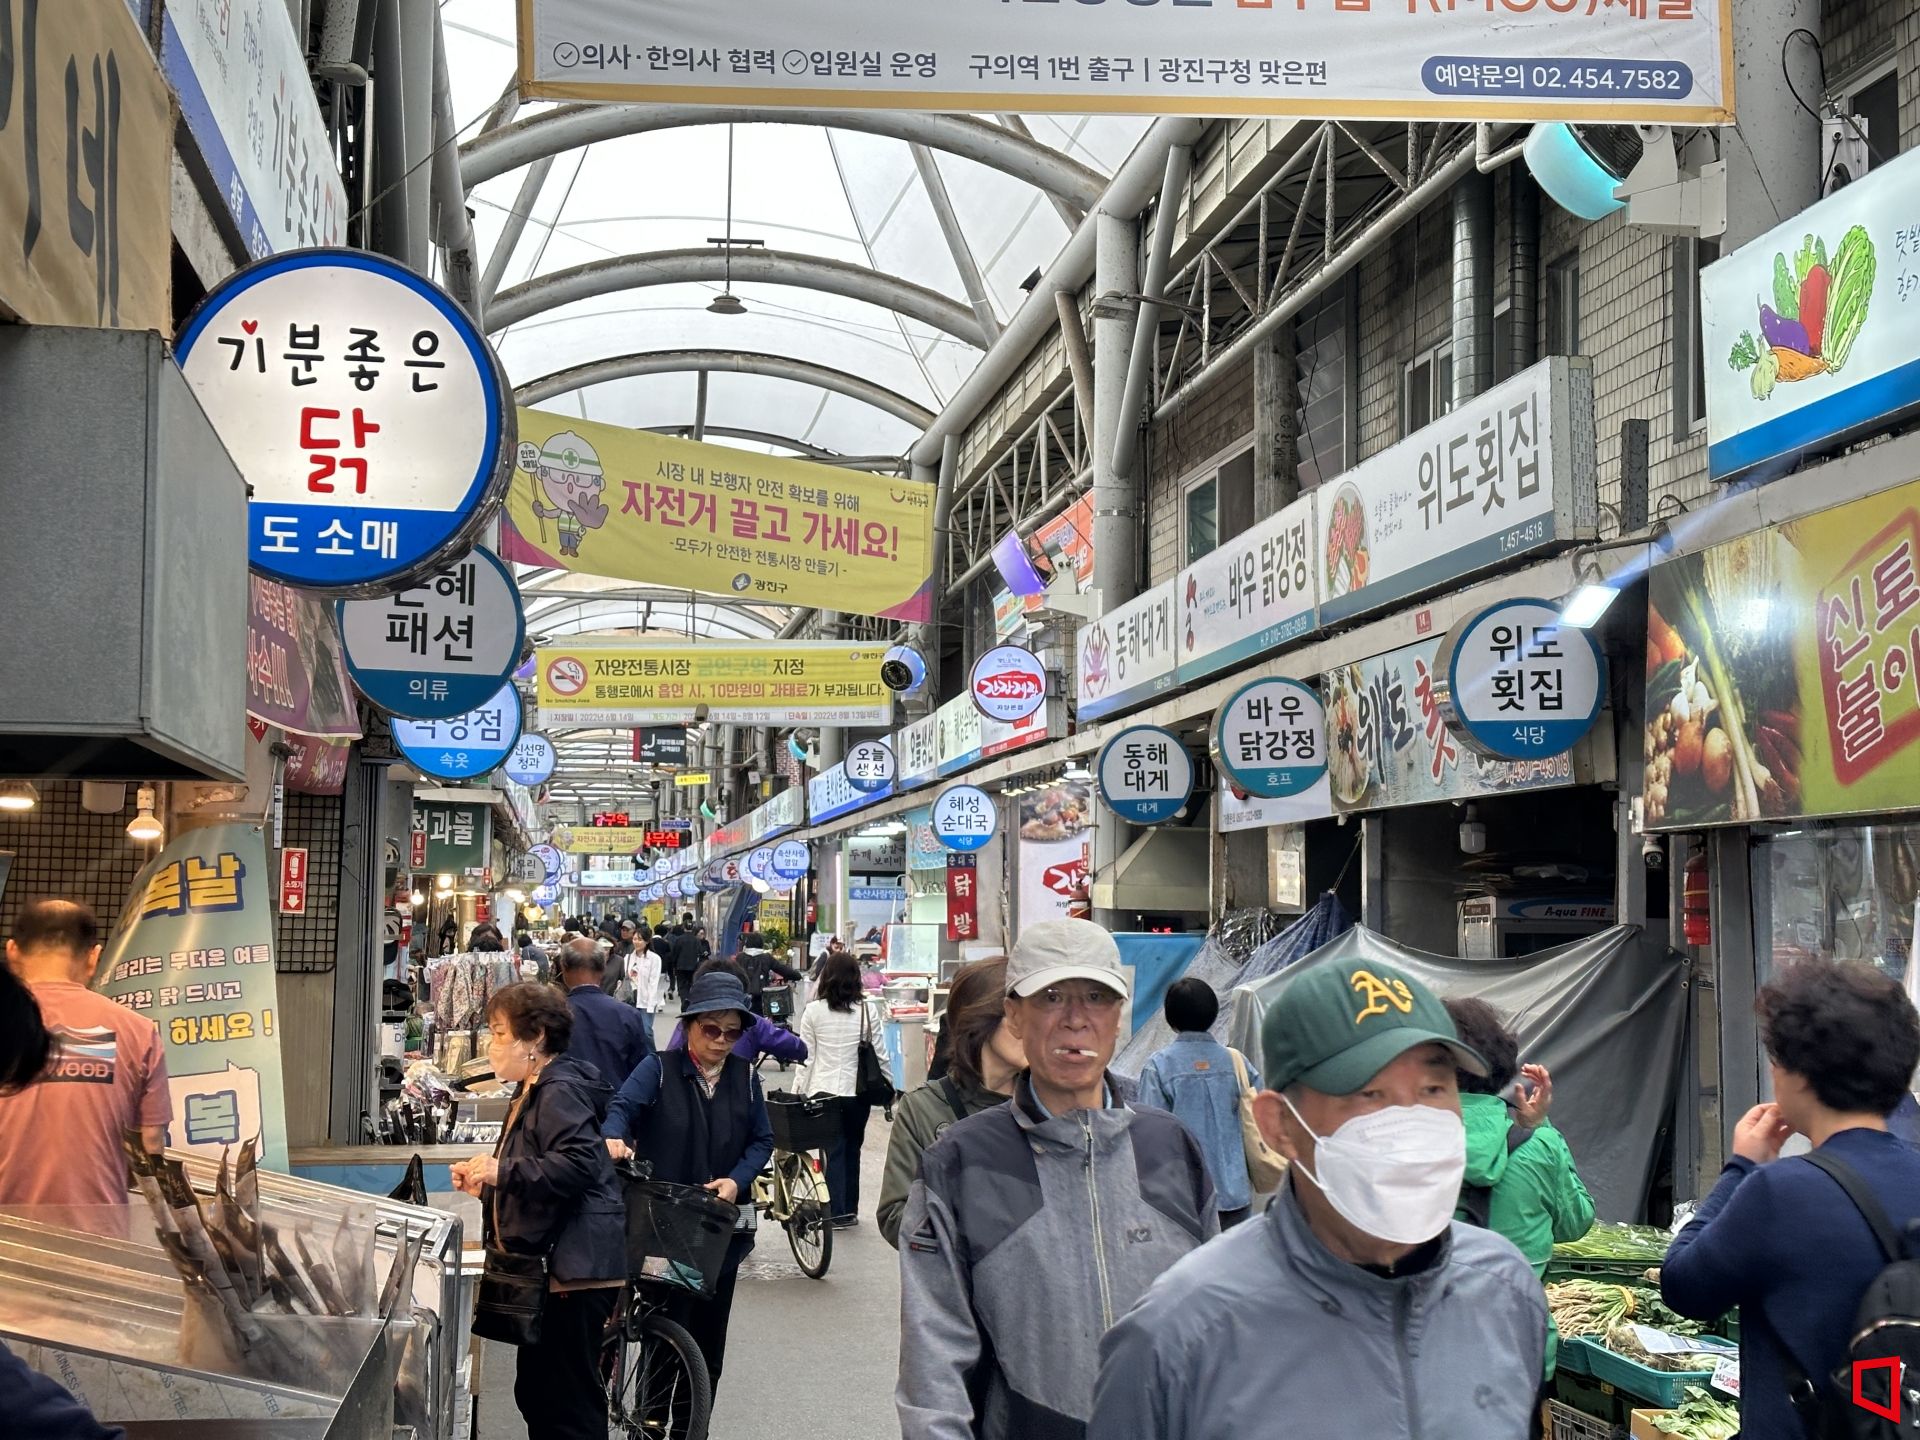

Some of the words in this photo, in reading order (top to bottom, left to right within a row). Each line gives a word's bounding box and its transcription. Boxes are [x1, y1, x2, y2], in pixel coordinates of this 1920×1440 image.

[582, 44, 721, 72] 의사·한의사
[728, 47, 776, 75] 협력
[809, 49, 882, 77] 입원실
[889, 51, 938, 78] 운영
[968, 53, 1040, 81] 구의역
[1047, 54, 1081, 82] 1번
[1088, 55, 1135, 84] 출구
[1158, 56, 1251, 85] 광진구청
[1258, 59, 1328, 87] 맞은편
[1434, 63, 1526, 90] 예약문의
[1531, 68, 1682, 91] 02.454.7582
[218, 322, 446, 392] 기분좋은
[300, 407, 380, 494] 닭
[521, 450, 536, 459] 안전
[1417, 391, 1541, 531] 위도횟집
[656, 460, 686, 482] 시장
[690, 467, 704, 486] 내
[710, 471, 752, 493] 보행자
[756, 477, 784, 499] 안전
[788, 484, 830, 508] 확보를
[833, 490, 860, 513] 위해
[620, 479, 717, 533] 자전거
[730, 497, 791, 544] 끌고
[802, 507, 899, 562] 가세요!
[1499, 520, 1543, 552] T.457-4518
[715, 544, 751, 565] 안전한
[755, 549, 802, 571] 전통시장
[805, 558, 839, 577] 만들기
[1229, 551, 1257, 619] 바우
[1261, 518, 1307, 608] 닭강정
[754, 580, 788, 595] 광진구
[385, 612, 473, 662] 패션
[1115, 597, 1169, 680] 동해대게
[1490, 624, 1564, 663] 위도
[595, 658, 692, 677] 자양전통시장
[773, 658, 804, 676] 지정
[408, 679, 450, 701] 의류
[595, 685, 654, 699] 통행로에서
[658, 683, 684, 699] 흡연
[689, 683, 705, 699] 시,
[710, 683, 765, 698] 10만원의
[770, 683, 820, 698] 과태료가
[824, 682, 885, 698] 부과됩니다.
[1491, 668, 1563, 712] 횟집
[1246, 696, 1304, 727] 바우
[1238, 728, 1315, 762] 닭강정
[1357, 683, 1417, 790] 위도
[1512, 724, 1546, 745] 식당
[439, 752, 470, 769] 속옷
[518, 757, 541, 770] 청과
[856, 748, 885, 762] 오늘
[1123, 743, 1168, 770] 동해
[856, 763, 885, 777] 생선
[1124, 769, 1169, 792] 대게
[1266, 773, 1293, 786] 호프
[949, 795, 980, 813] 혜성
[1137, 802, 1158, 814] 대게
[941, 815, 989, 832] 순대국
[957, 837, 973, 846] 식당
[948, 855, 977, 869] 순대국
[1544, 905, 1577, 918] Aqua
[1580, 907, 1607, 918] FINE
[170, 948, 226, 970] 무더운
[233, 944, 271, 965] 여름
[159, 987, 179, 1007] 닭
[185, 981, 242, 1003] 드시고
[1350, 970, 1413, 1025] A's
[170, 1012, 254, 1045] 하세요
[1126, 1228, 1153, 1244] K2
